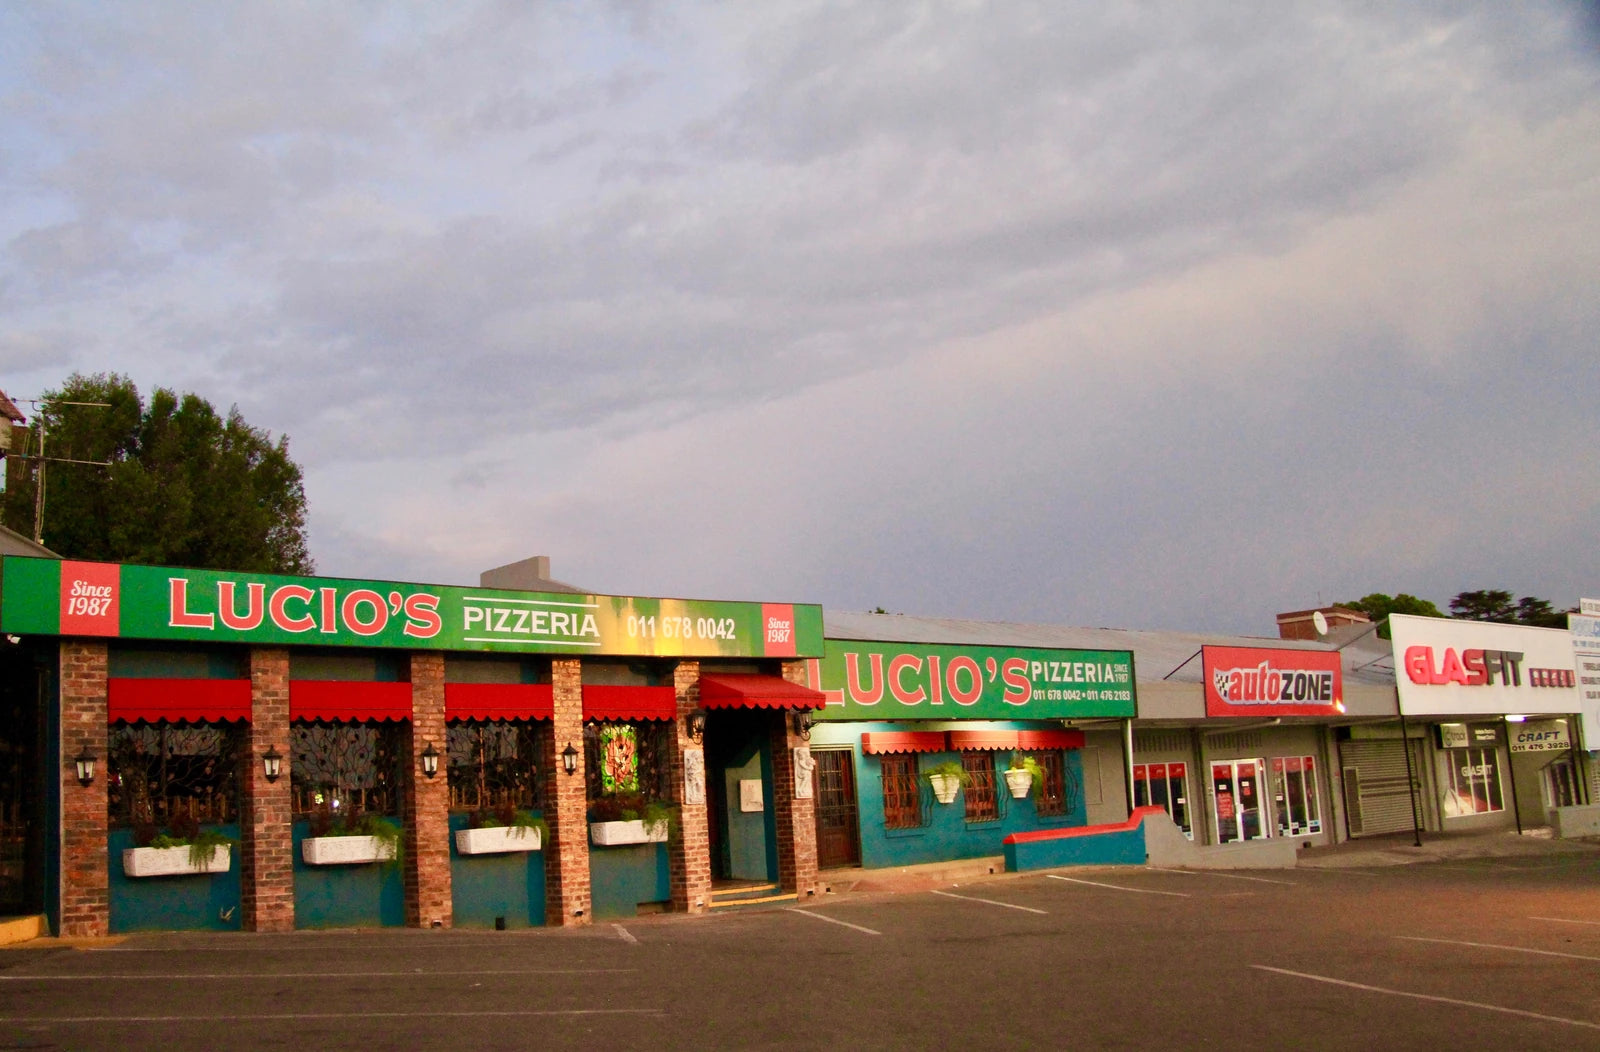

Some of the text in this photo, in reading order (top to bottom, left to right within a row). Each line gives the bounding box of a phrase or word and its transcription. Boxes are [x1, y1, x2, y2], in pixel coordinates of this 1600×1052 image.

[70, 580, 113, 597] Since
[67, 597, 113, 617] 1987
[168, 577, 443, 639] LUCIO'S
[463, 606, 601, 638] PIZZERIA
[627, 615, 736, 640] 011 678 0042
[767, 617, 790, 629] Since
[767, 629, 790, 644] 1987
[1031, 660, 1115, 683] PIZZERIA
[1114, 663, 1128, 673] SINCE
[1404, 645, 1524, 687] GLASFIT
[807, 652, 1032, 707] LUCIO'S
[1115, 673, 1128, 683] 1987
[1228, 660, 1332, 702] autoZONE
[1033, 689, 1130, 701] 011 678 0042 011 476 2183
[1517, 731, 1561, 743] CRAFT
[1528, 743, 1544, 751] 476
[1547, 742, 1570, 750] 3928
[1461, 764, 1493, 777] GASIT
